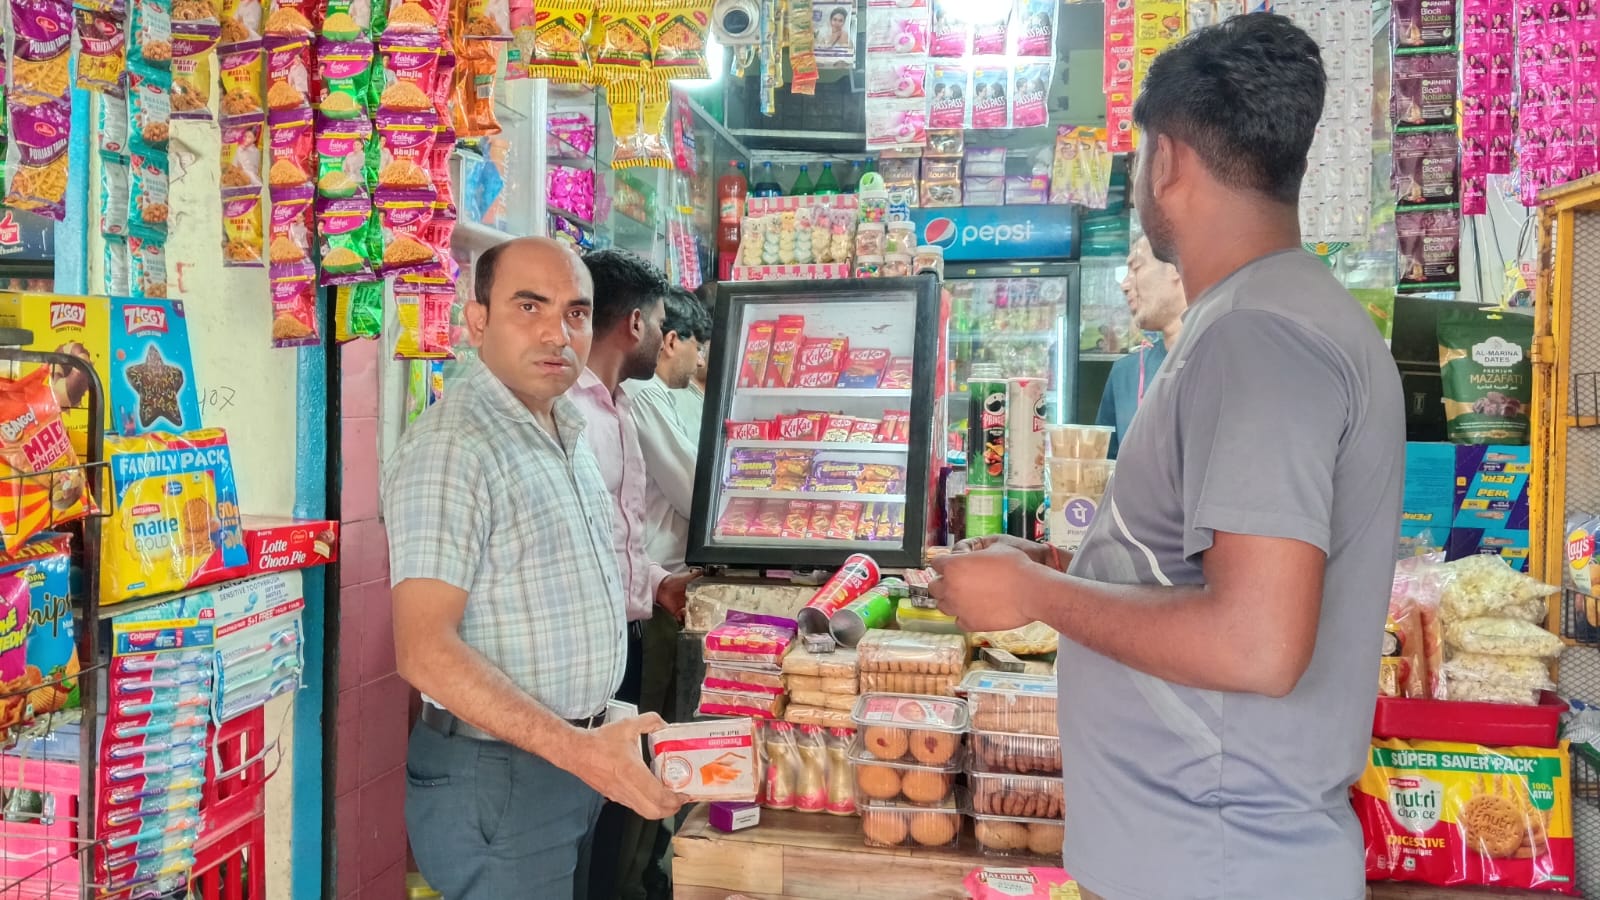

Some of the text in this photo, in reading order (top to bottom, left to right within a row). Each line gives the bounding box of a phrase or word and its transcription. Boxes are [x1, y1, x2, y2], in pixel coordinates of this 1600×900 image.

[396, 70, 423, 78] Bhujia
[933, 97, 963, 111] PASS PASS
[975, 96, 1005, 111] PASS PASS
[1015, 94, 1031, 107] PASS
[394, 148, 419, 156] Bhujia
[962, 220, 1032, 246] pepsi
[51, 303, 86, 327] ZIGGY
[125, 306, 166, 332] ZIGGY
[805, 348, 834, 365] KitKat
[852, 350, 884, 360] KitKat
[803, 372, 833, 386] KitKat
[1470, 374, 1523, 385] MAZAFATI
[1, 408, 39, 440] BINGO!
[735, 424, 759, 439] KitKat
[783, 418, 812, 436] KitKat
[119, 449, 226, 475] FAMILY PACK
[1481, 473, 1515, 484] PERK
[1476, 489, 1509, 498] PERK
[1072, 502, 1088, 524] पे
[133, 516, 178, 538] marie
[260, 539, 288, 555] Lotte
[259, 551, 307, 570] Choco Pie
[259, 610, 274, 622] FREE
[129, 632, 156, 643] Colgate
[708, 738, 743, 747] Premium
[1441, 754, 1490, 770] SAVER
[1532, 782, 1552, 790] 100%
[1396, 790, 1436, 808] nutri
[1482, 814, 1516, 829] nutri
[1387, 835, 1446, 849] DIGESTIVE
